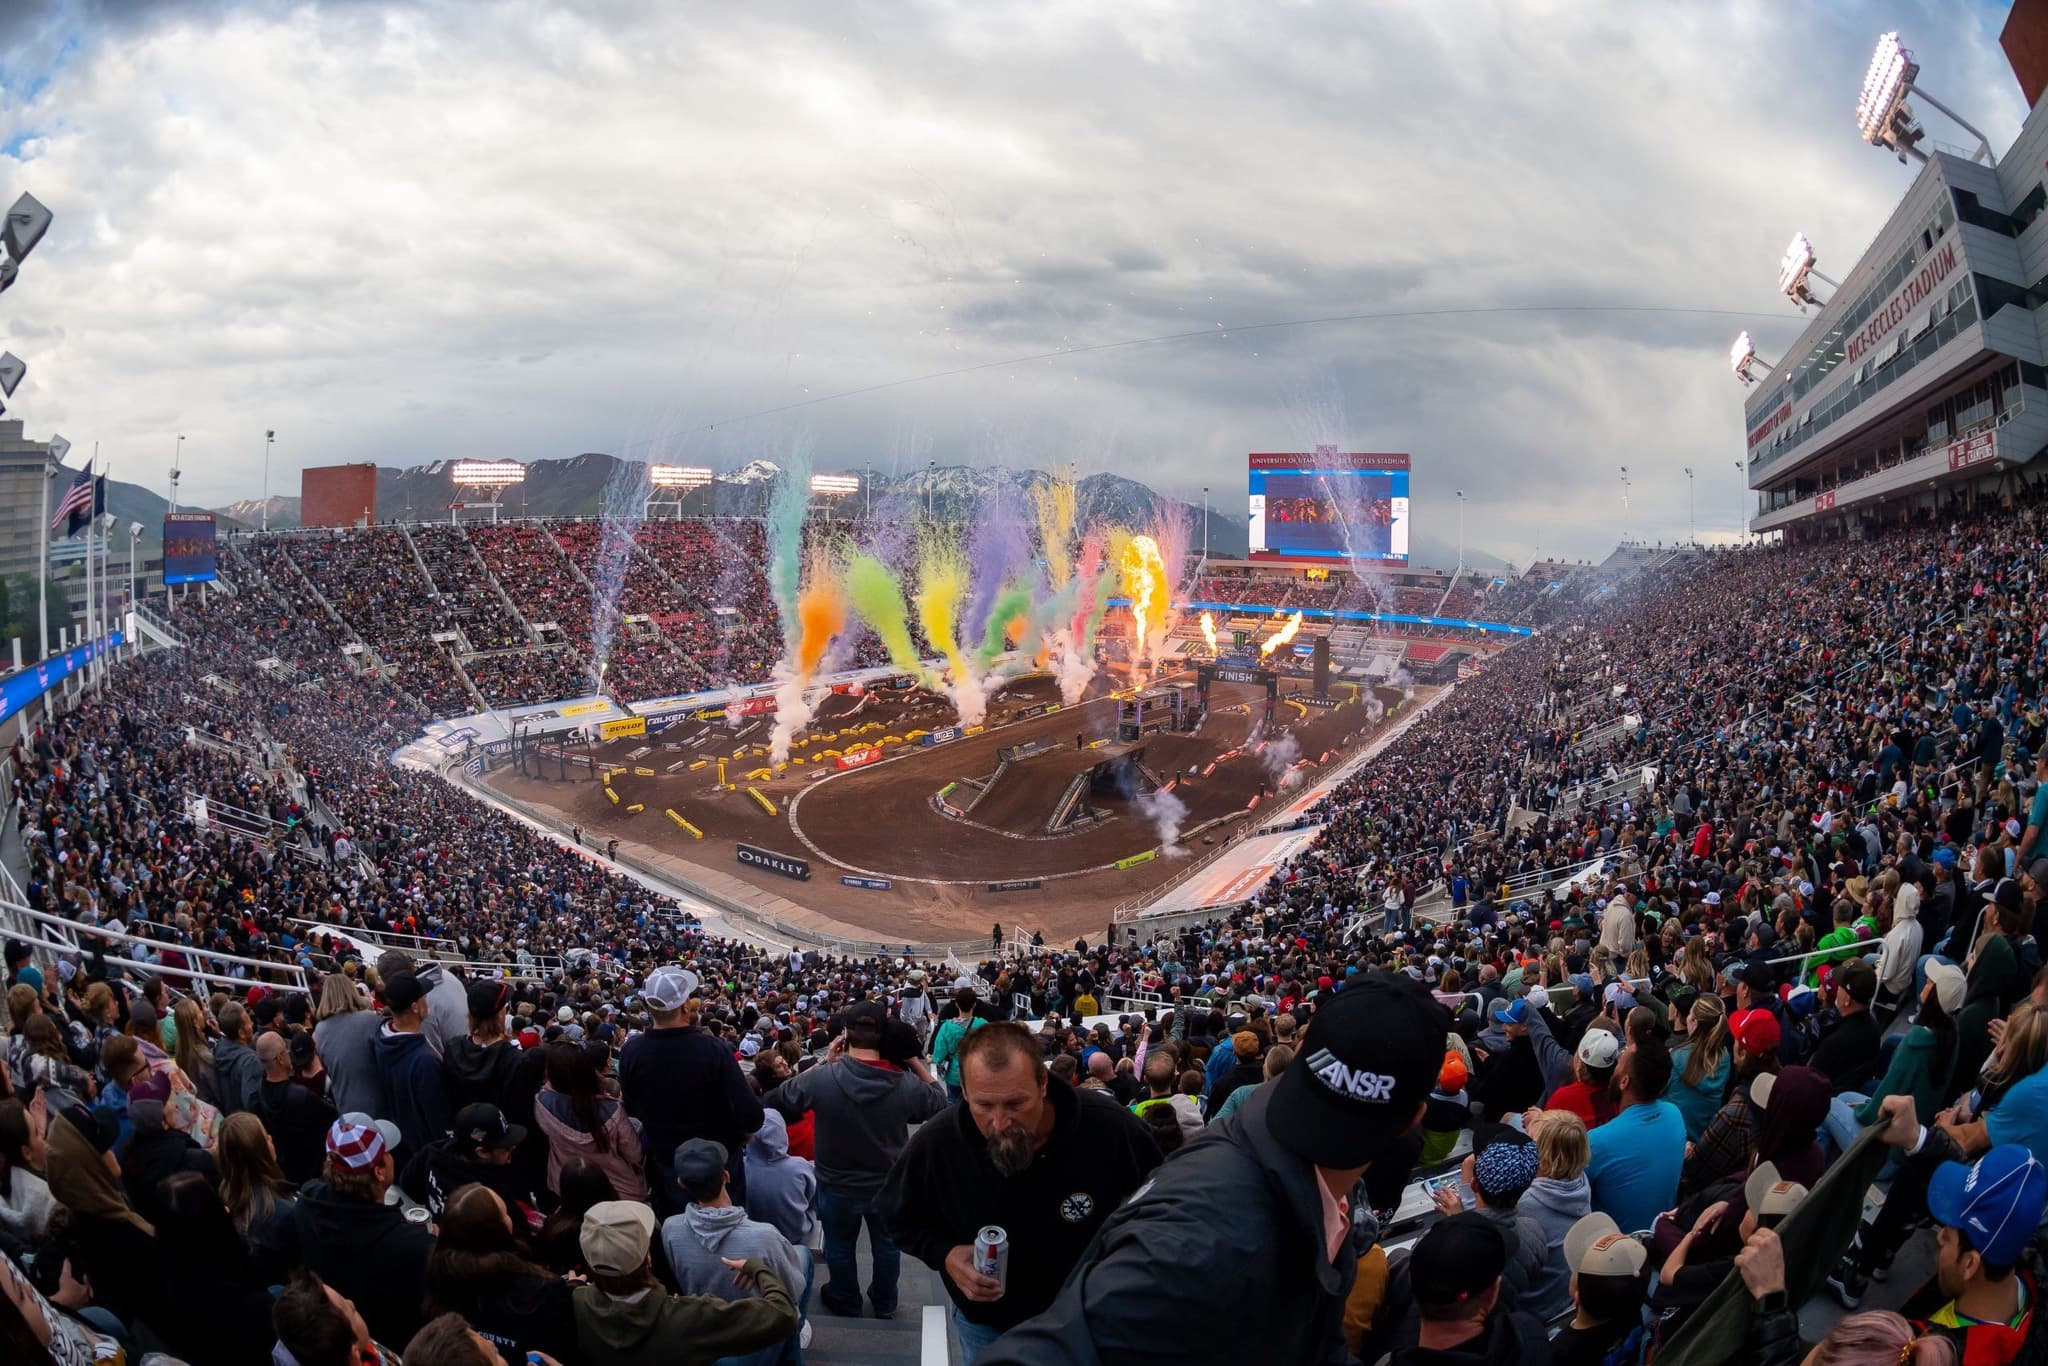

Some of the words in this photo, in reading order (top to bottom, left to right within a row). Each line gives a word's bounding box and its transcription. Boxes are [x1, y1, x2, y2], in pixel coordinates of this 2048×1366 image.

[1848, 296, 1903, 365] RICE-ECCLES
[1902, 241, 1957, 313] STADIUM
[1252, 457, 1286, 465] UNIVERSITY
[1218, 671, 1253, 682] FINISH
[647, 713, 686, 726] FALKEN
[608, 722, 643, 733] DUNLOP
[755, 855, 803, 875] OAKLEY
[1314, 1058, 1397, 1101] ANSR
